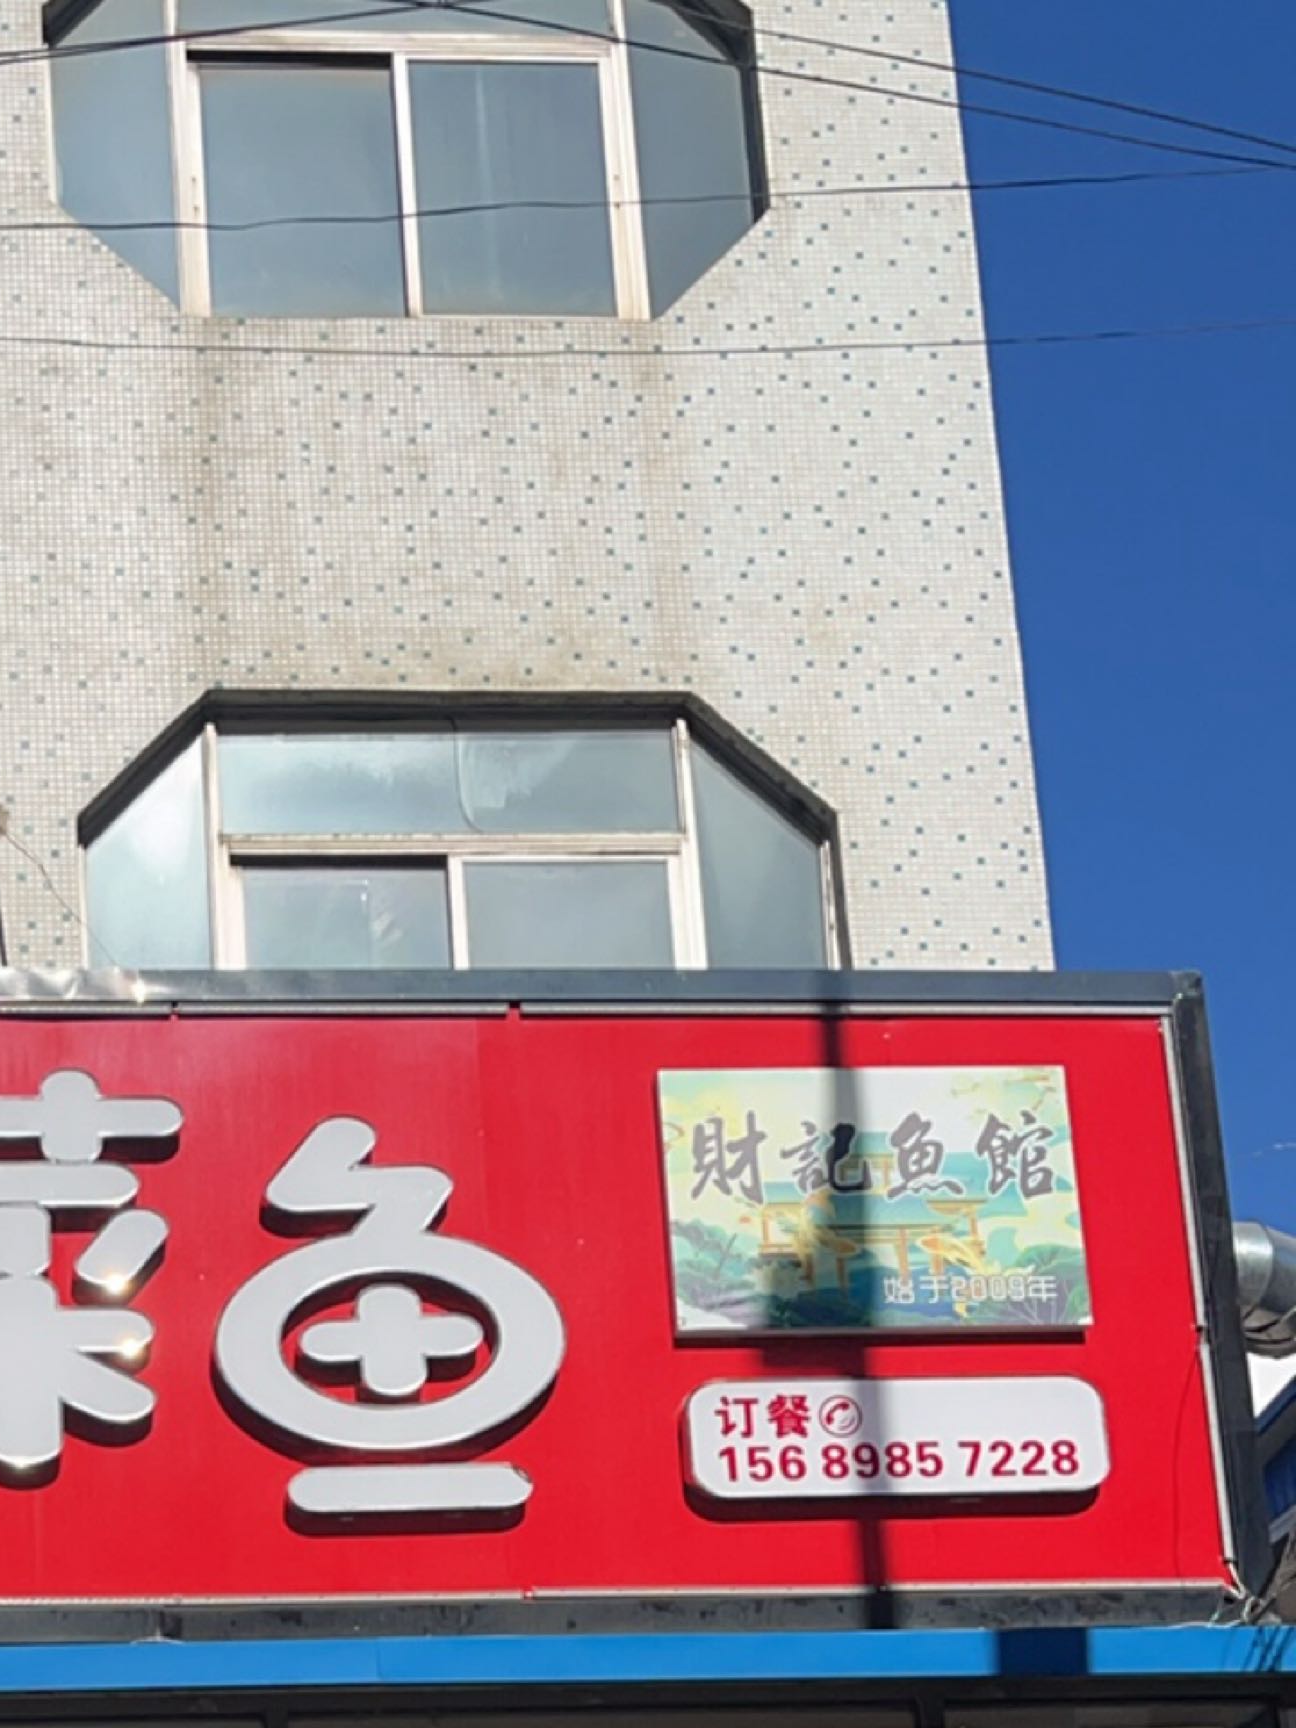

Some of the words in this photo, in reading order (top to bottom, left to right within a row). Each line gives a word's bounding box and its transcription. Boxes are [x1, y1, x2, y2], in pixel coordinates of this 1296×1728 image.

[690, 1110, 1056, 1206] 財記魚館
[882, 1273, 1058, 1305] 始于2009年
[713, 1394, 811, 1440] 订餐
[717, 1444, 808, 1482] 156
[820, 1440, 945, 1481] 8985
[956, 1438, 1081, 1478] 7228
